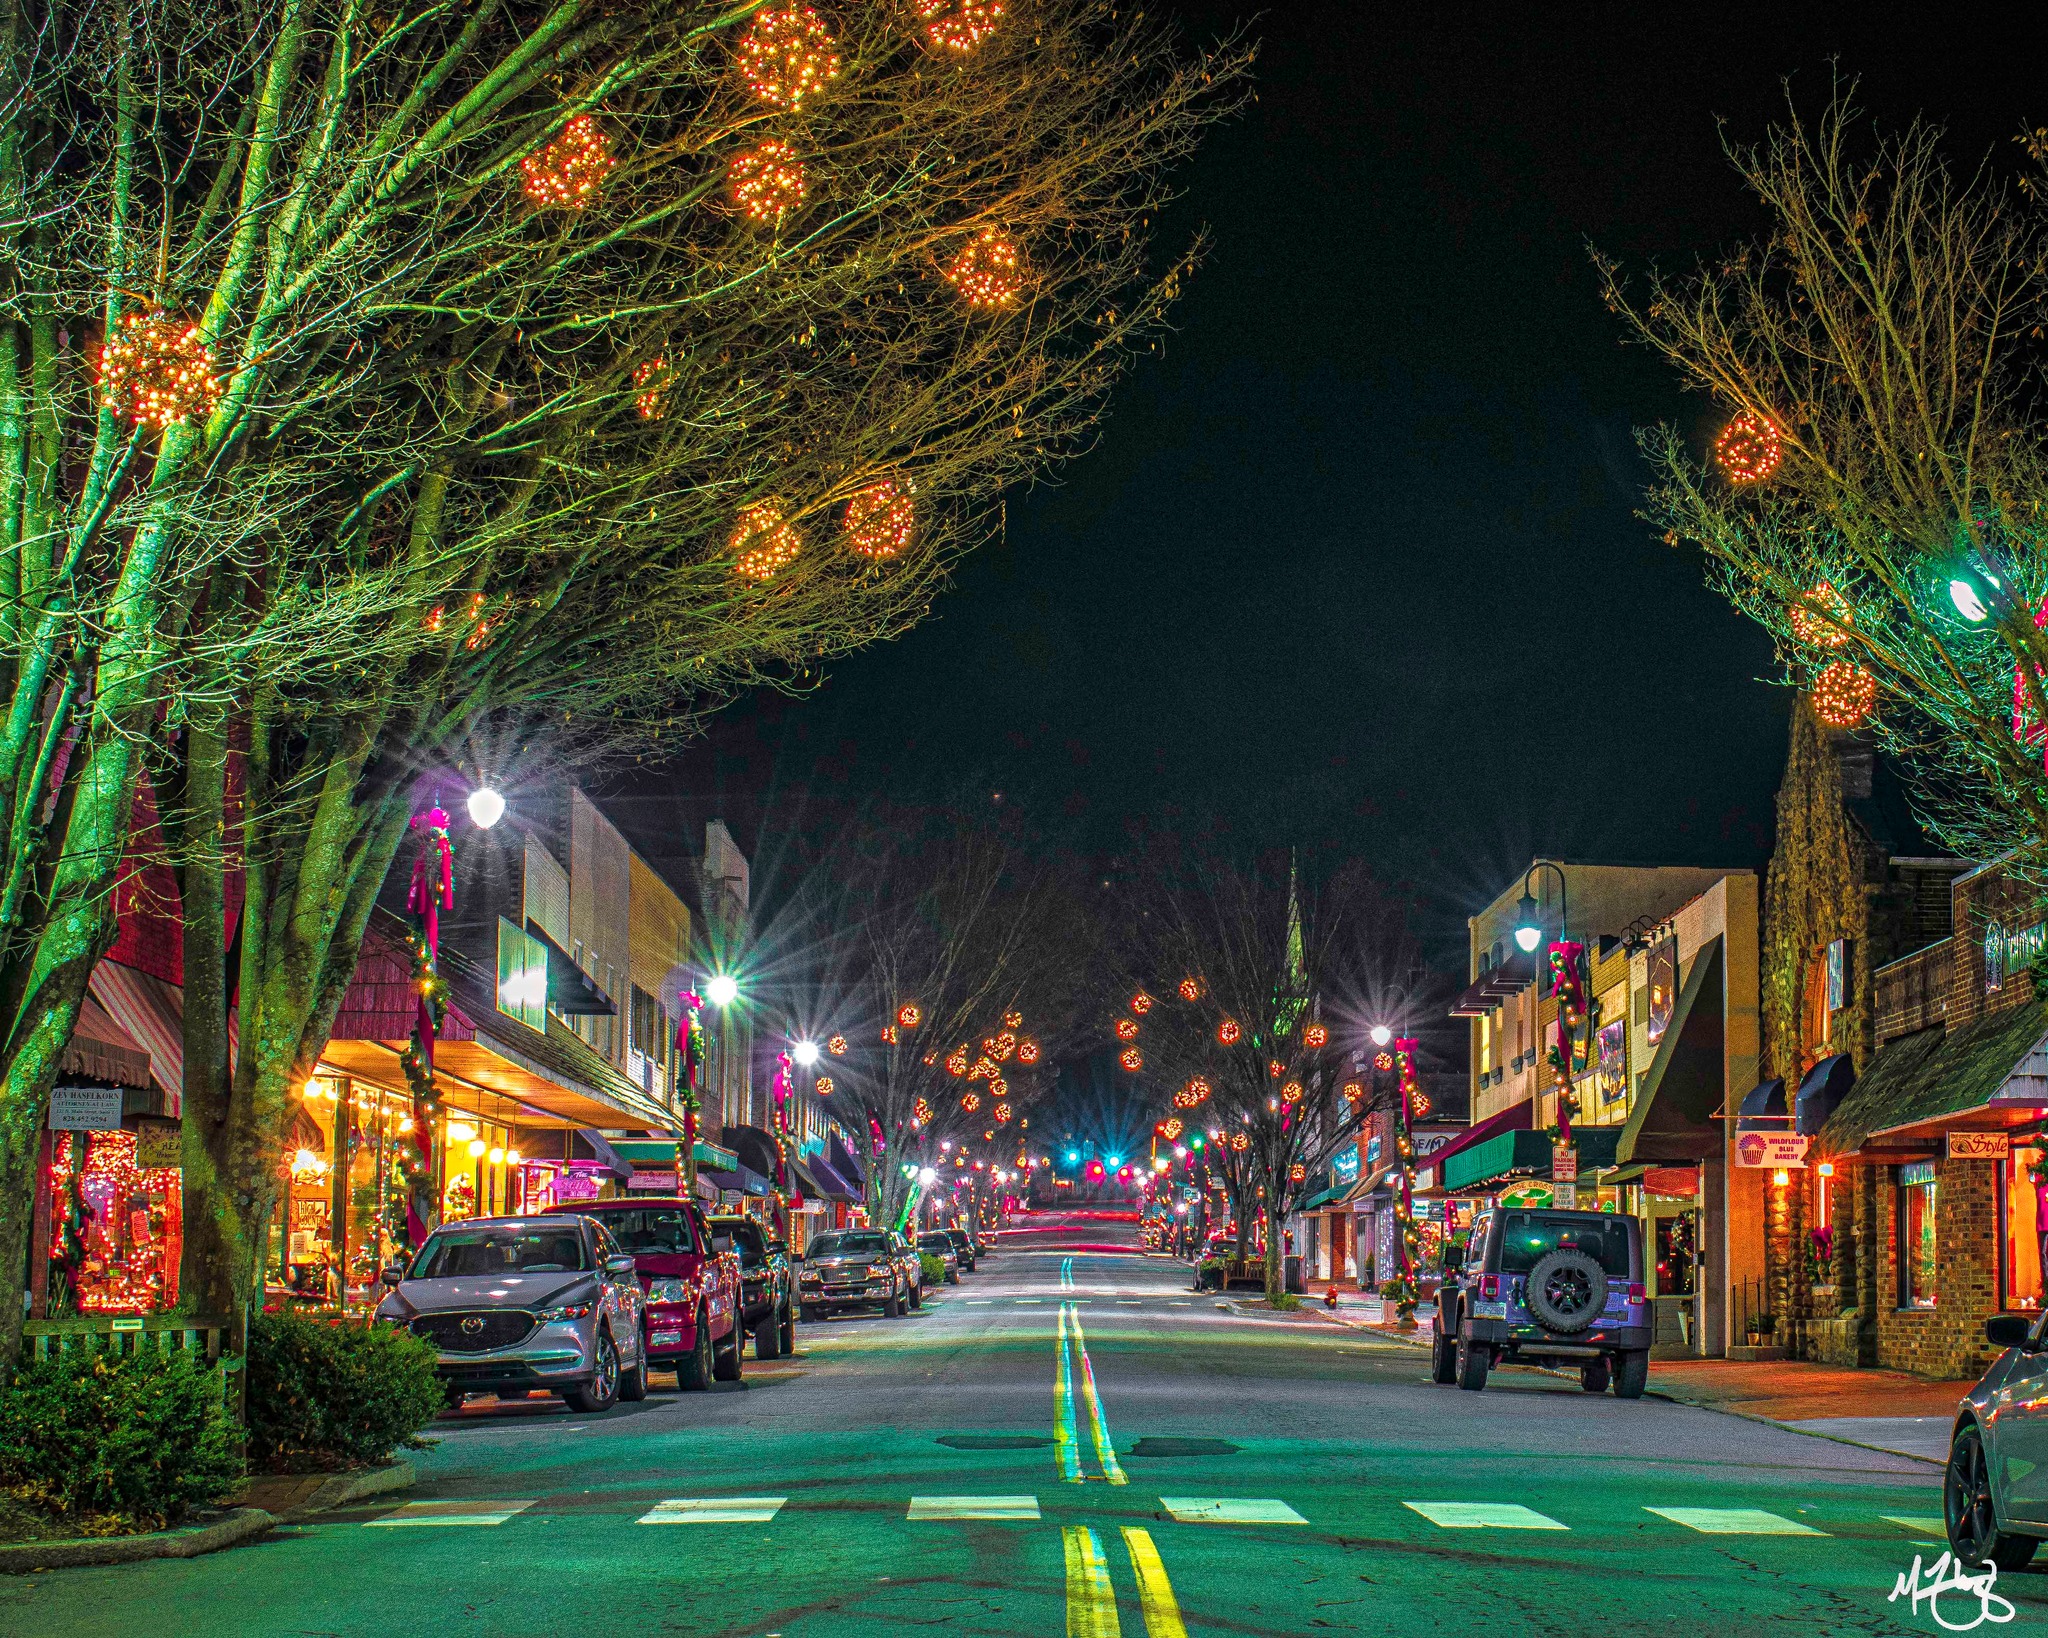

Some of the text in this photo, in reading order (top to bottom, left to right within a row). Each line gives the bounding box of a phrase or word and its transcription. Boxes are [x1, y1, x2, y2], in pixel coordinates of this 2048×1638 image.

[1970, 1134, 2008, 1157] Style
[1501, 1181, 1554, 1198] MOOSE CROSS
